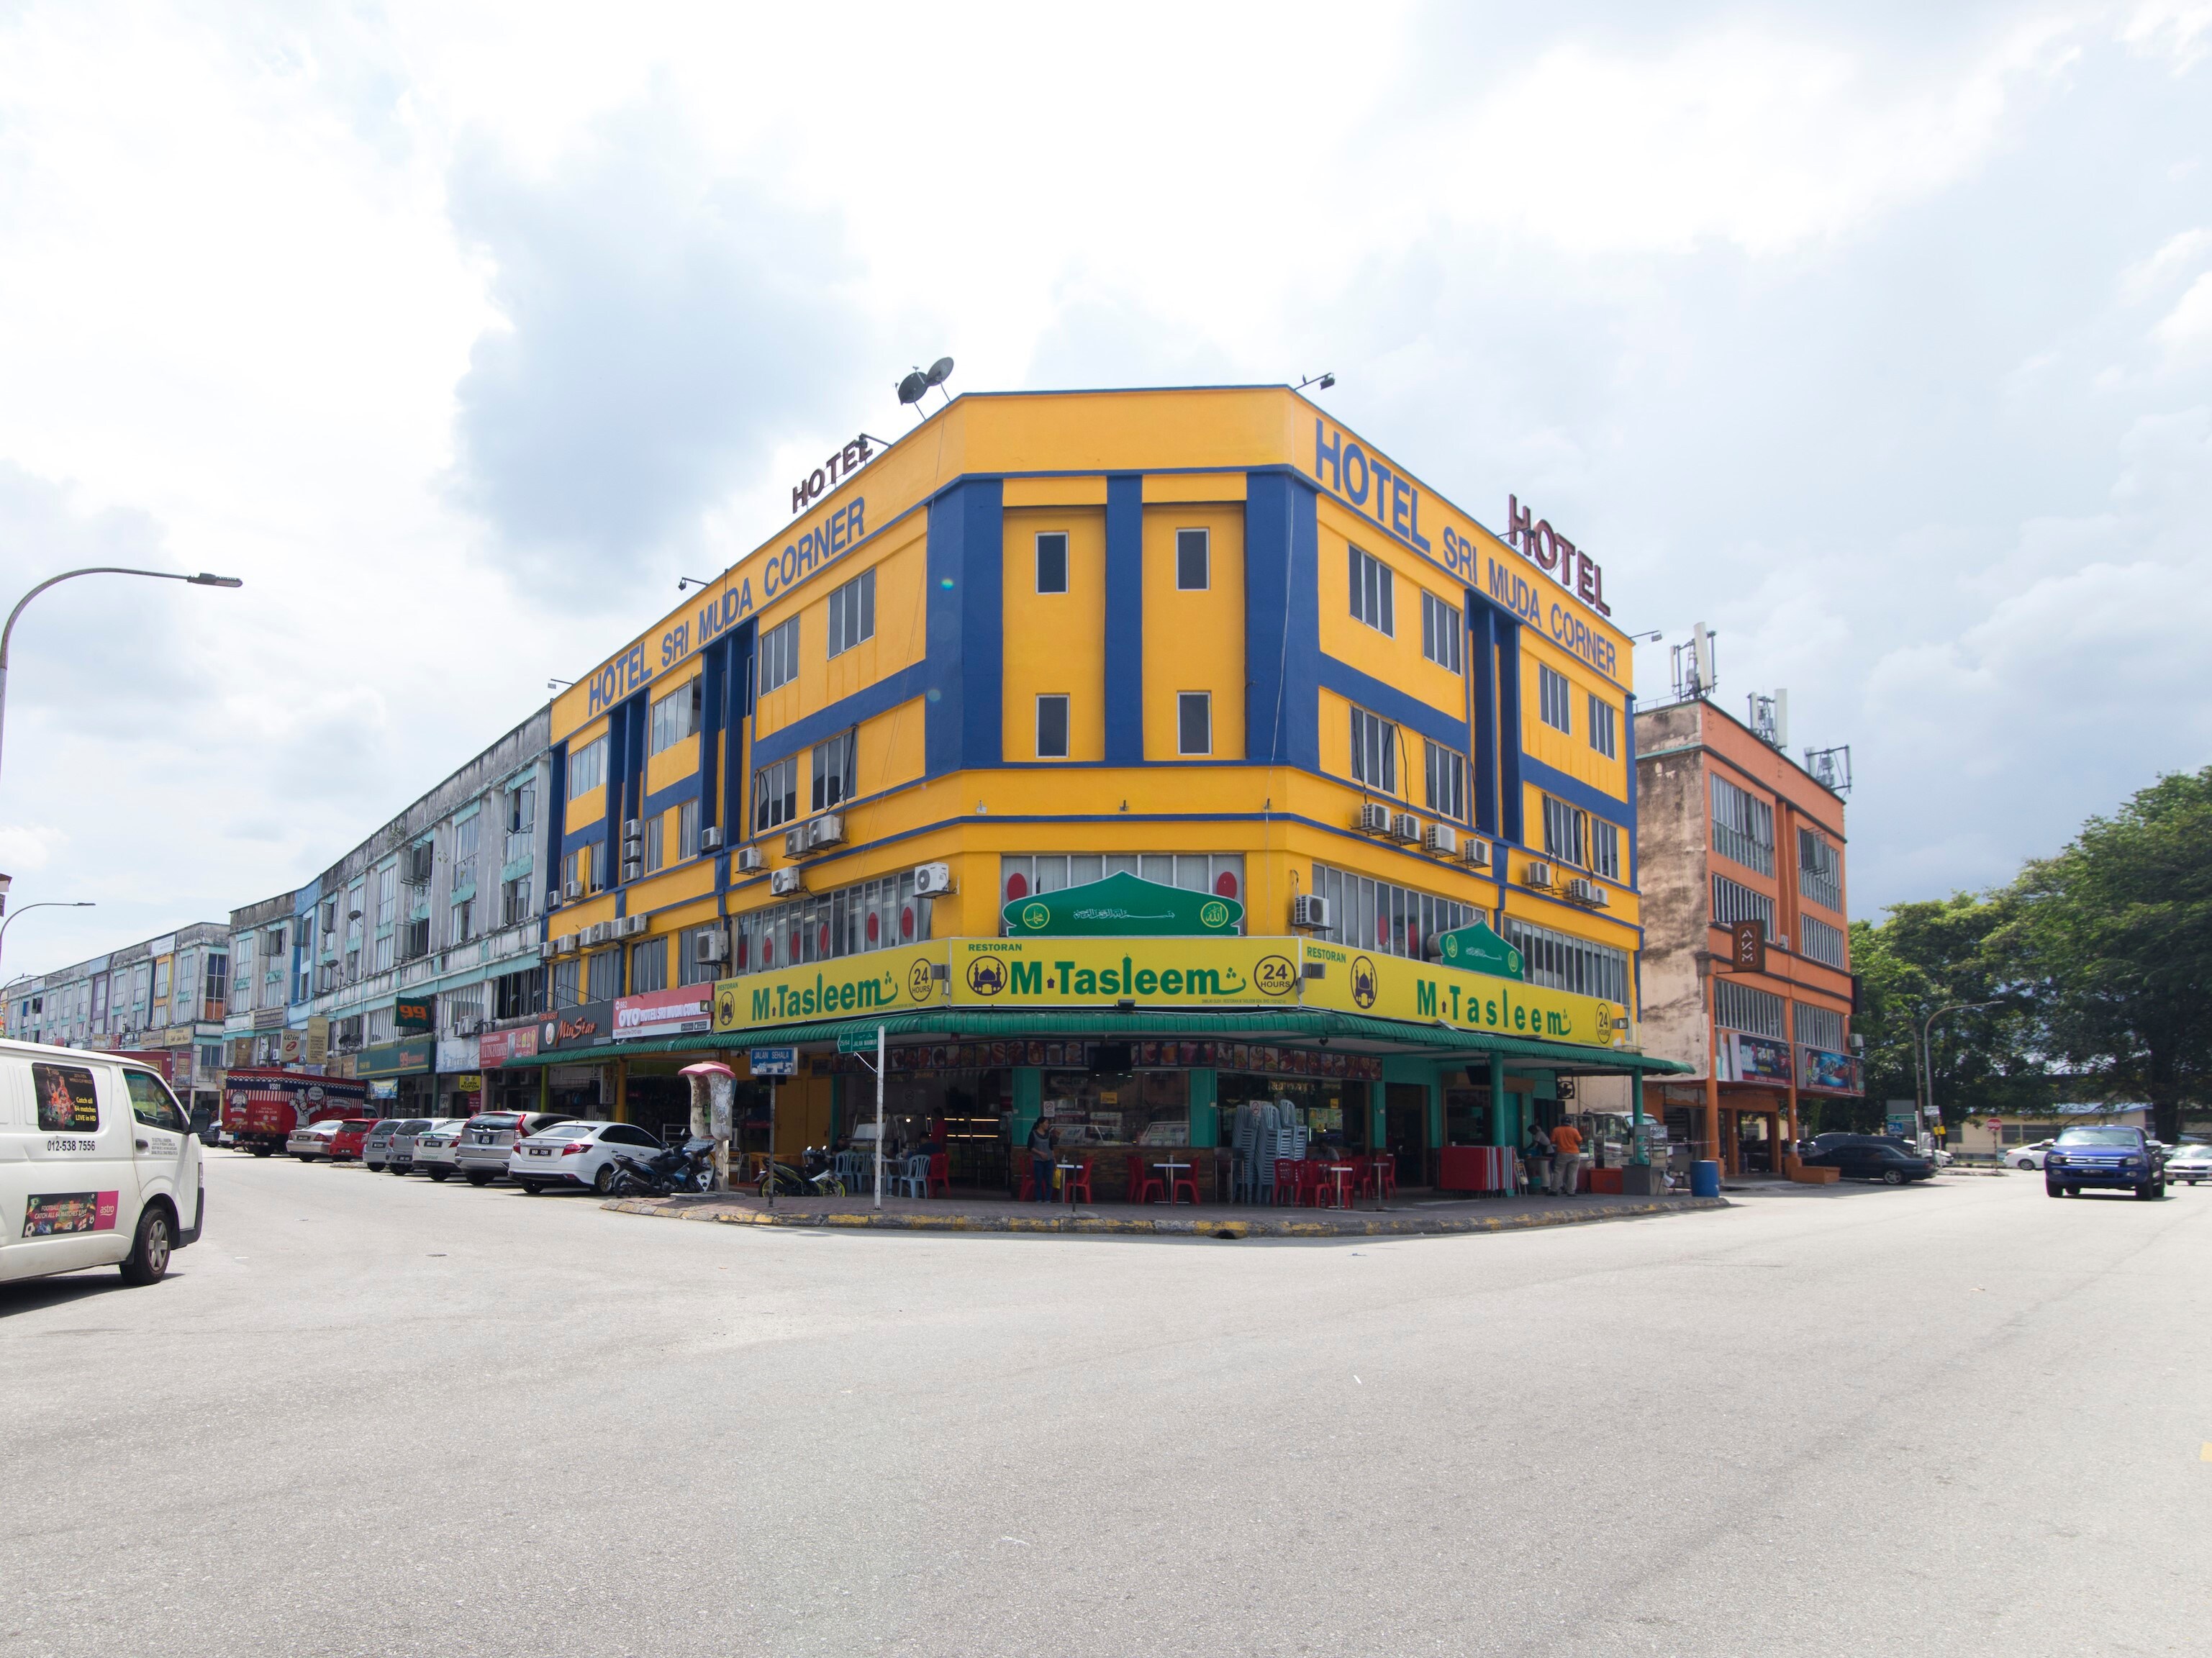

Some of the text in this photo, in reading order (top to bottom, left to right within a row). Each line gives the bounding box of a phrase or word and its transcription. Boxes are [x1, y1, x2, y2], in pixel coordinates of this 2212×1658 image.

[792, 438, 873, 514] HOTEL
[1316, 418, 1616, 677] HOTEL SRI MUDA CORNER
[1509, 494, 1611, 617] HOTEL
[589, 497, 865, 717] HOTEL SRI MUDA CORNER
[1307, 946, 1346, 964] RESTORAN
[913, 967, 929, 986] 24
[1263, 964, 1287, 980] 24
[717, 982, 738, 992] RESTORAN
[912, 984, 930, 995] HOURS
[399, 1005, 427, 1020] 99
[618, 1002, 709, 1027] OYO HOTEL SRI MUDA CORN
[1599, 1012, 1608, 1028] 24
[284, 1033, 299, 1041] Win
[399, 1052, 408, 1069] 99
[754, 1051, 789, 1060] JALAN SEHALA
[47, 1140, 96, 1151] 012-538 7556
